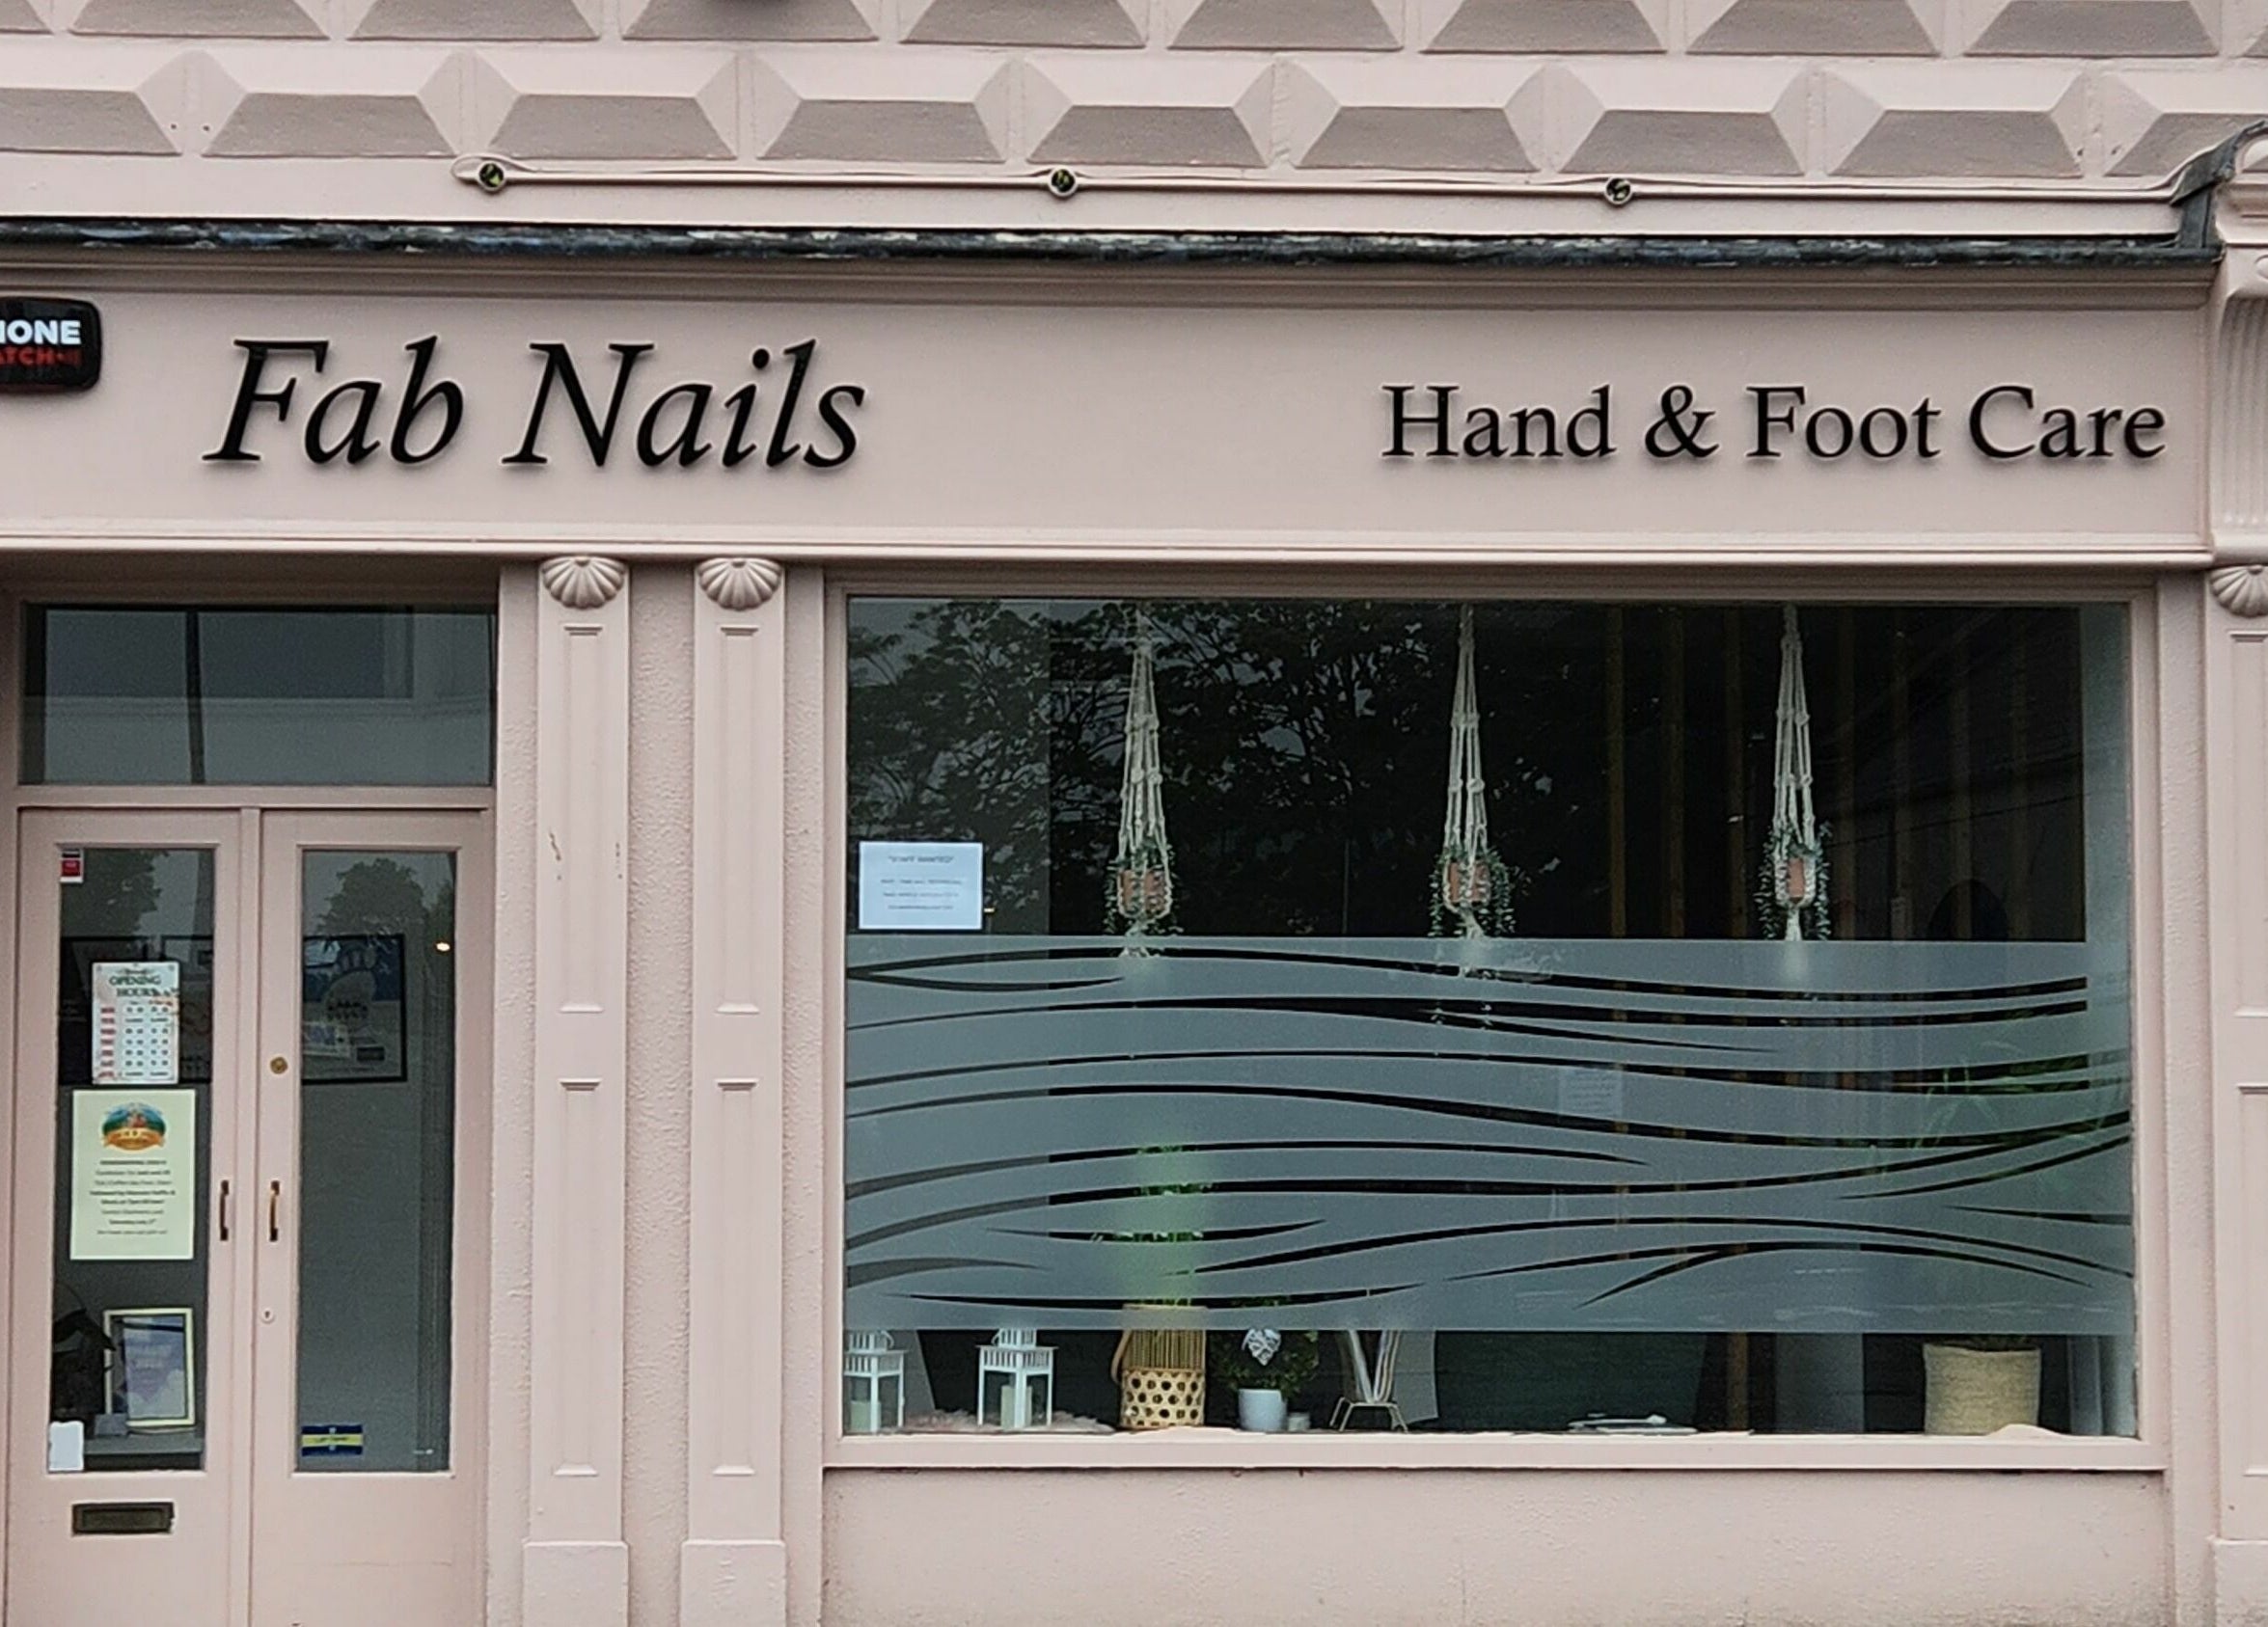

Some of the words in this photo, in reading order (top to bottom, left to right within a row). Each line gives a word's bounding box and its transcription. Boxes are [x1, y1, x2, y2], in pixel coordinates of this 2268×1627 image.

[0, 319, 81, 345] ONE
[203, 336, 463, 466] Fab
[503, 339, 864, 469] Nails
[1383, 386, 1615, 458] Hand
[1646, 386, 1718, 460] &
[1747, 387, 1940, 458] Foot
[1970, 386, 2164, 458] Care
